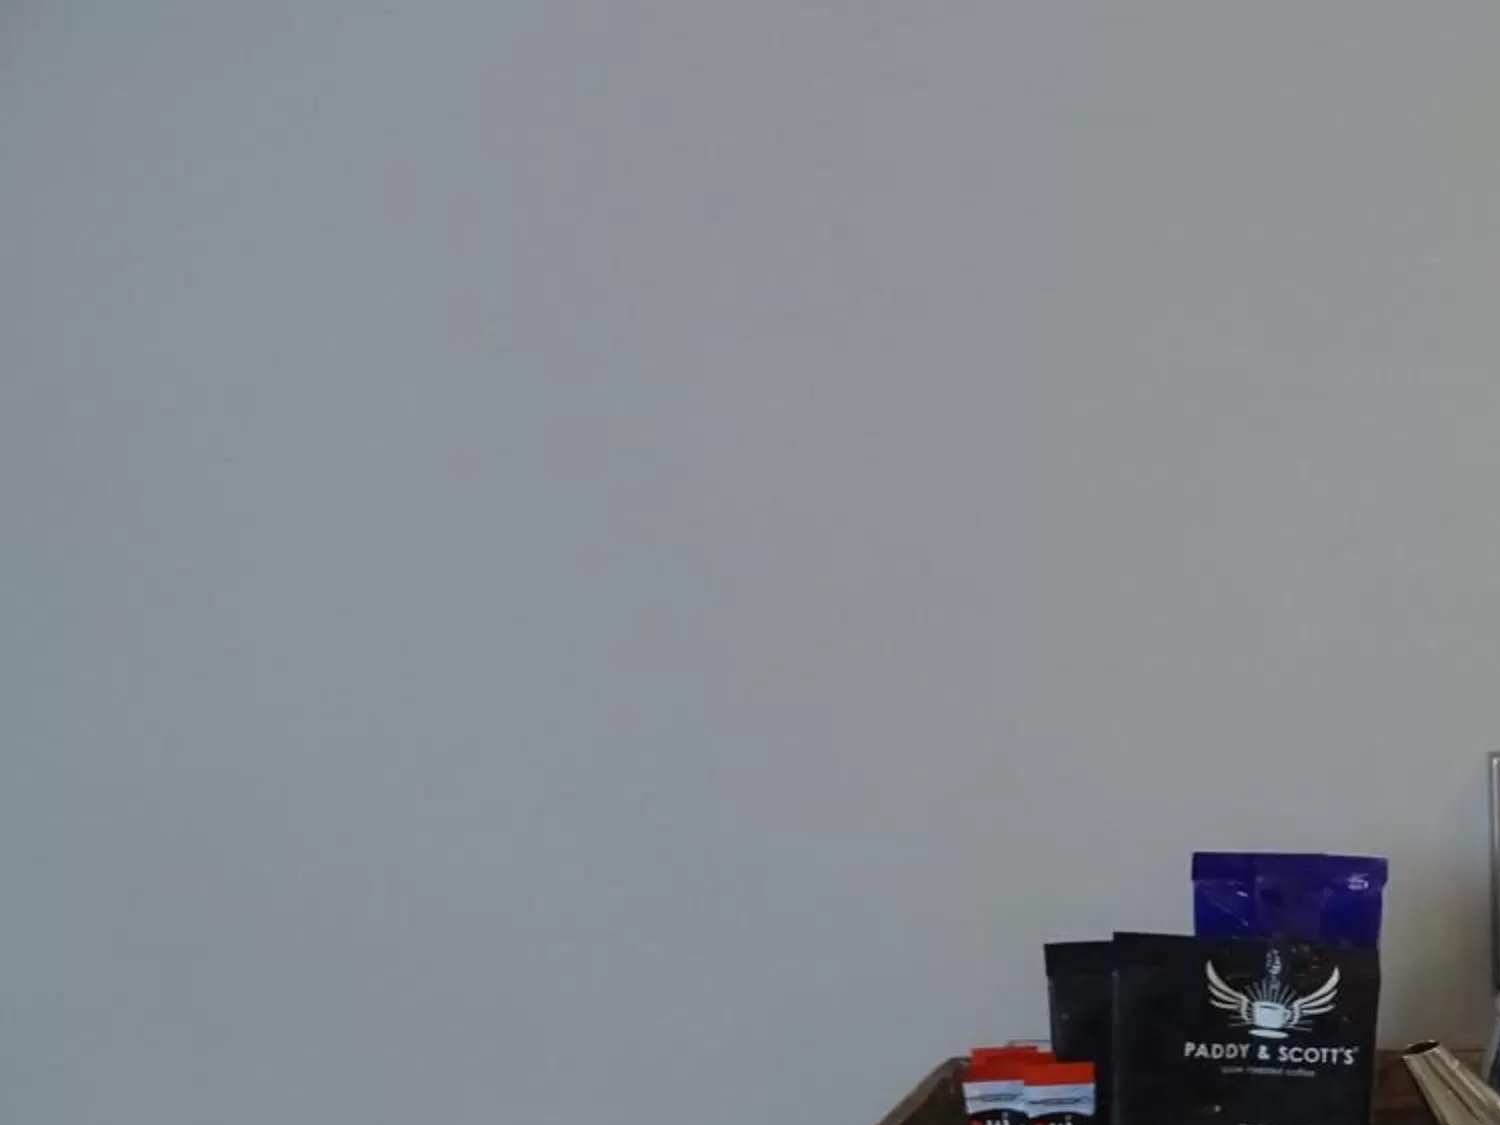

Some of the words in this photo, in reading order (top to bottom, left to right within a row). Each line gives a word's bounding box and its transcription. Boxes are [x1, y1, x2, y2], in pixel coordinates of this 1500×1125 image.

[1184, 1041, 1250, 1060] PADDY
[1257, 1045, 1270, 1061] &
[1278, 1046, 1355, 1066] SCOTT'S
